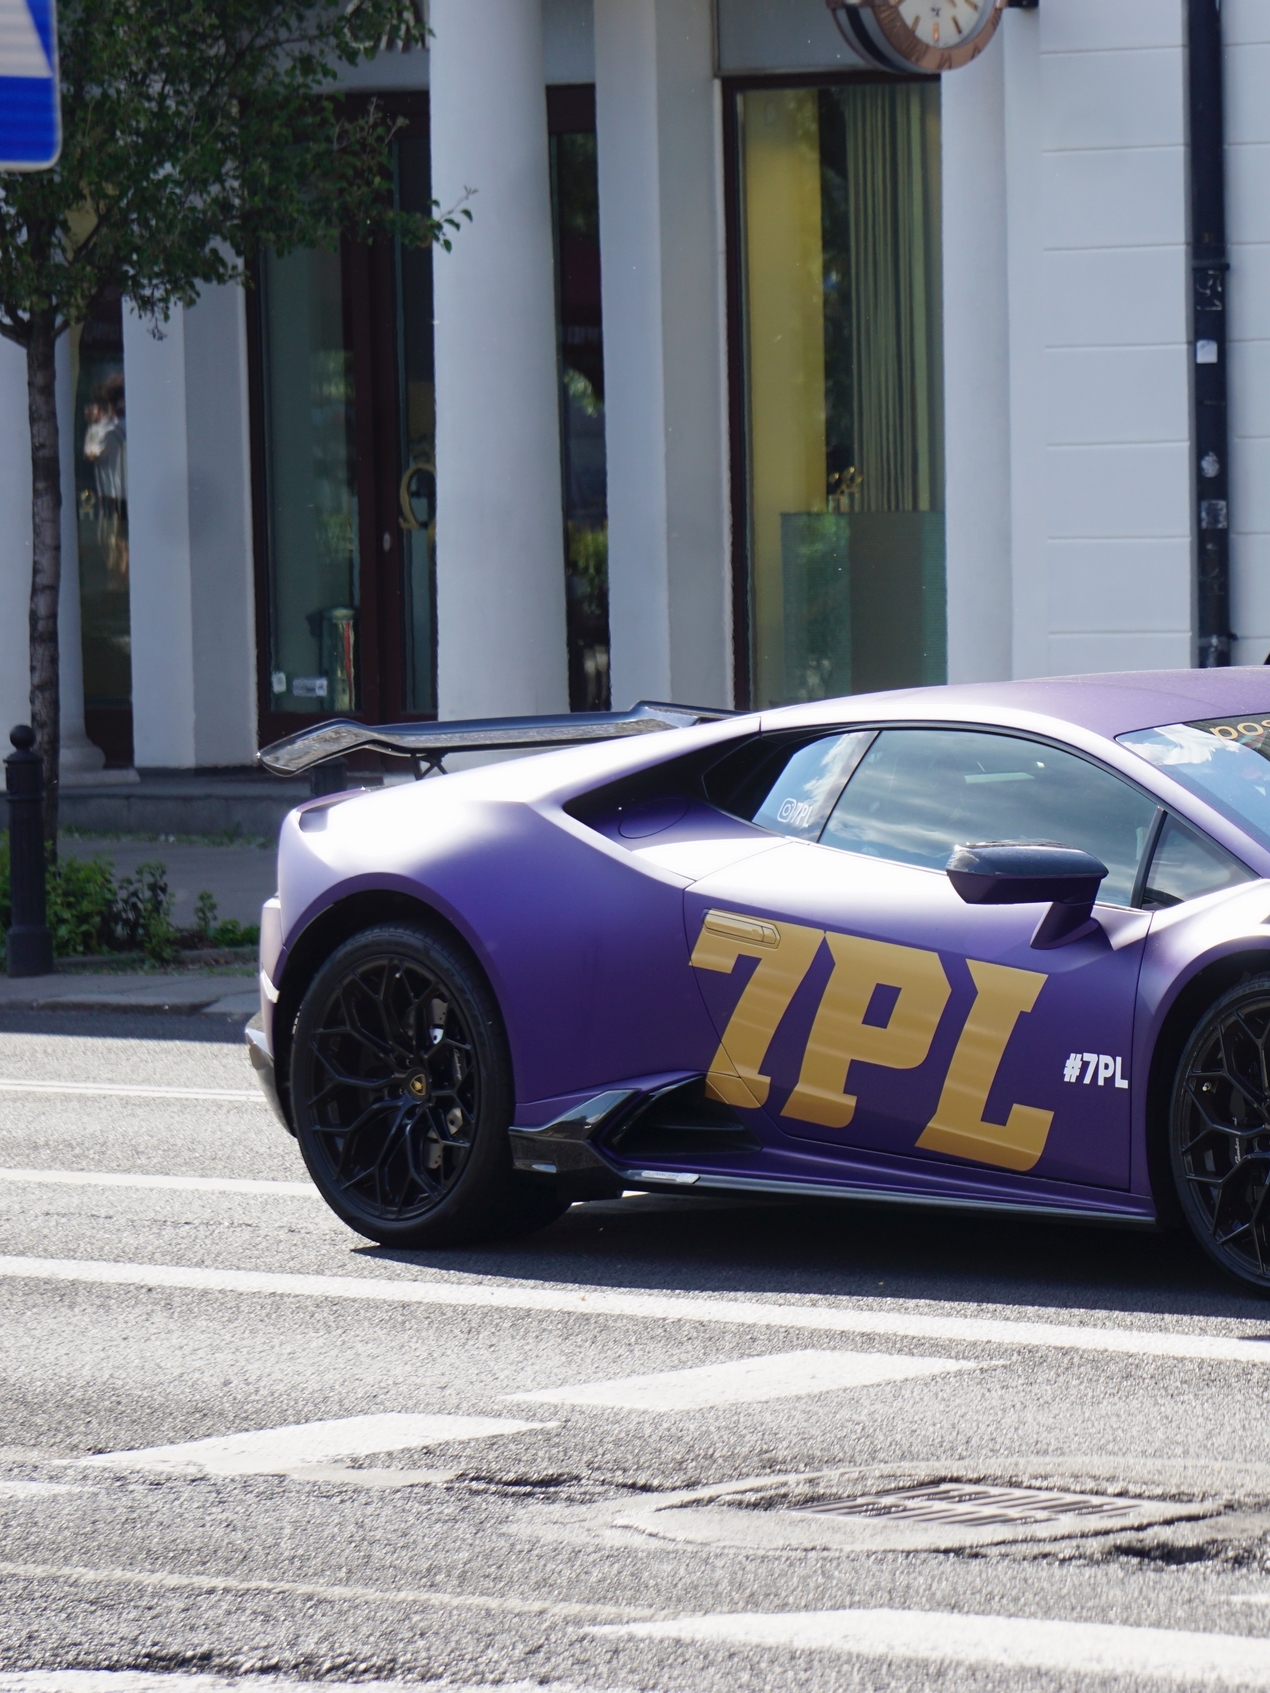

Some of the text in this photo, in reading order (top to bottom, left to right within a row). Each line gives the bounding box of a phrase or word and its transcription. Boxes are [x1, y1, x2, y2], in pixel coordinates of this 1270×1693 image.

[791, 802, 814, 828] 7PL
[688, 908, 1055, 1172] 7PL
[1063, 1052, 1129, 1089] #7PL
